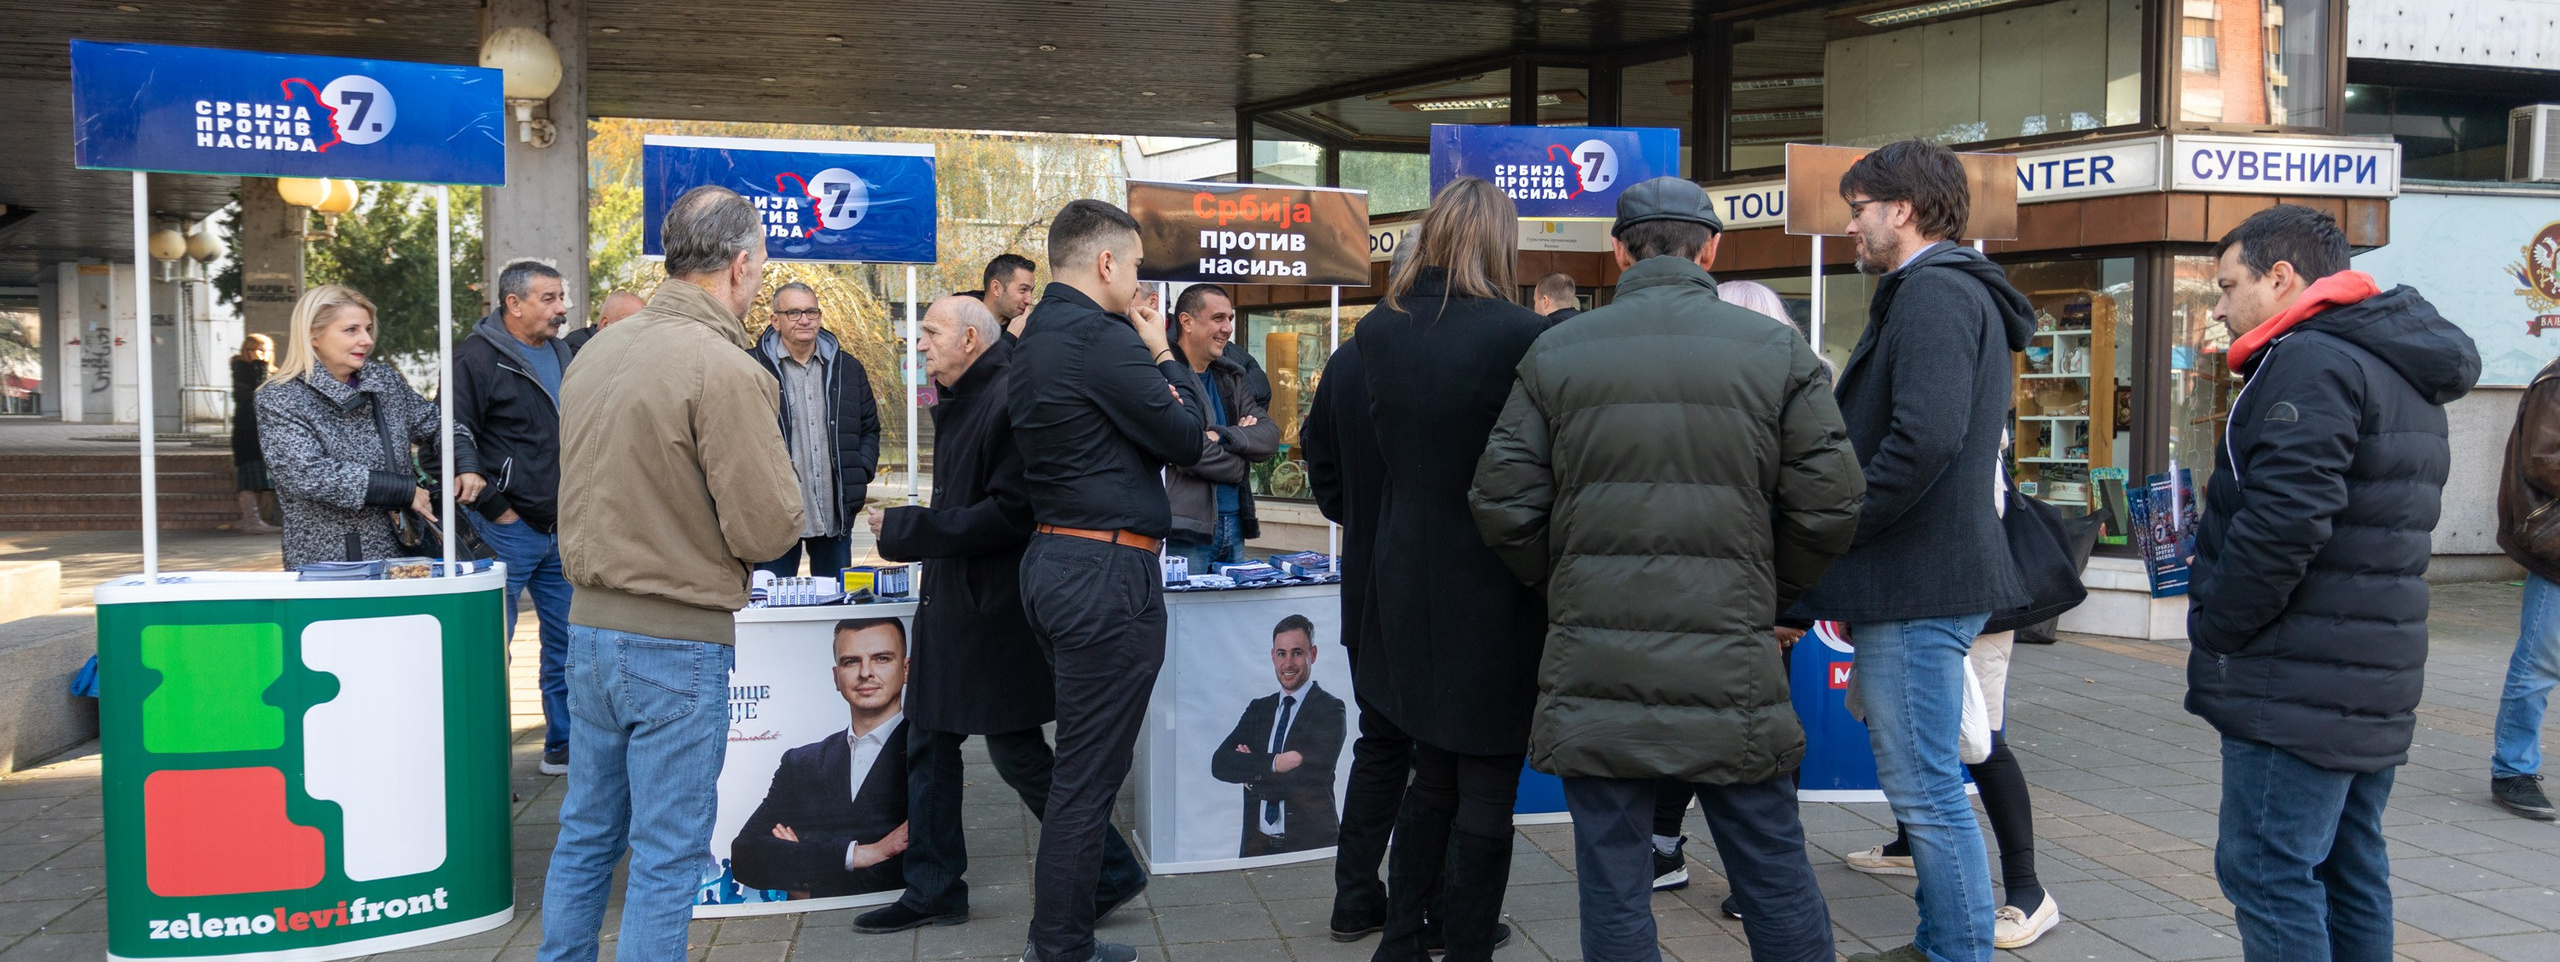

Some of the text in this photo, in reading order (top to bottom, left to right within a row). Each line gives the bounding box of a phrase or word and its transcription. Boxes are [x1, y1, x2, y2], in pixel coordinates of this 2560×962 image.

[195, 100, 311, 121] СРБИЈА
[341, 91, 382, 132] 7.
[196, 116, 311, 136] ПРОТИВ
[196, 132, 318, 152] НАСИЉА
[1494, 164, 1565, 176] СРБИЈА
[1584, 151, 1610, 182] 7.
[2191, 148, 2376, 185] СУВЕНИРИ
[1495, 177, 1565, 188] ПРОТИВ
[1724, 155, 2115, 220] TOU NTER
[741, 195, 799, 210] ИЈА
[823, 182, 858, 218] 7.
[1500, 188, 1569, 199] АСИЉА
[757, 210, 799, 224] ТИВ
[1193, 191, 1312, 229] Србија
[1200, 230, 1306, 255] против
[1369, 231, 1394, 254] ФО
[1199, 257, 1308, 277] насиља
[2541, 316, 2560, 327] ВАЉ
[728, 685, 770, 702] ИЦЕ
[149, 887, 448, 940] zelenolevifront
